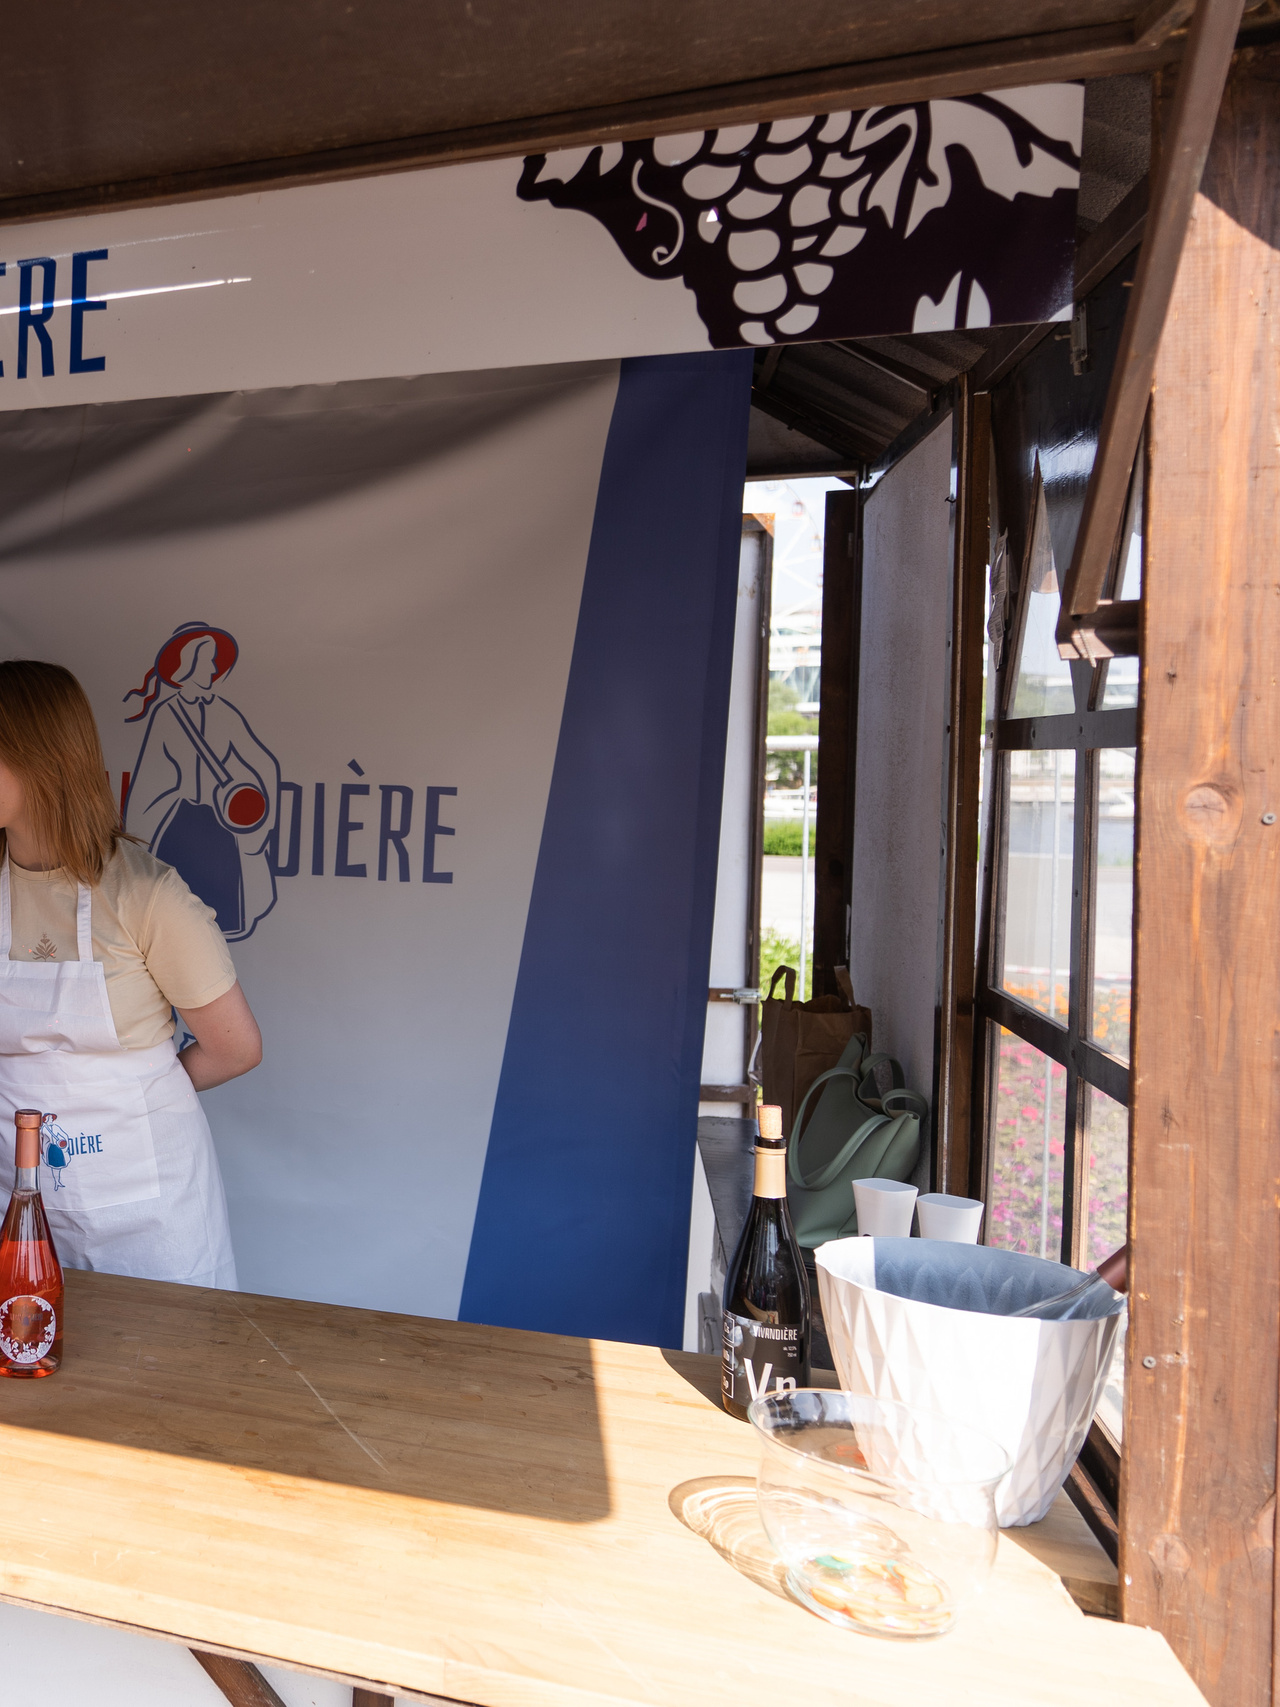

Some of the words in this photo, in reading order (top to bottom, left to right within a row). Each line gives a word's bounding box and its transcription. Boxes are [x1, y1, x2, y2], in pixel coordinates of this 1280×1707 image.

[273, 758, 458, 884] DIÈRE
[67, 1132, 103, 1156] DIÈRE
[753, 1325, 798, 1341] VIVANDIÈRE
